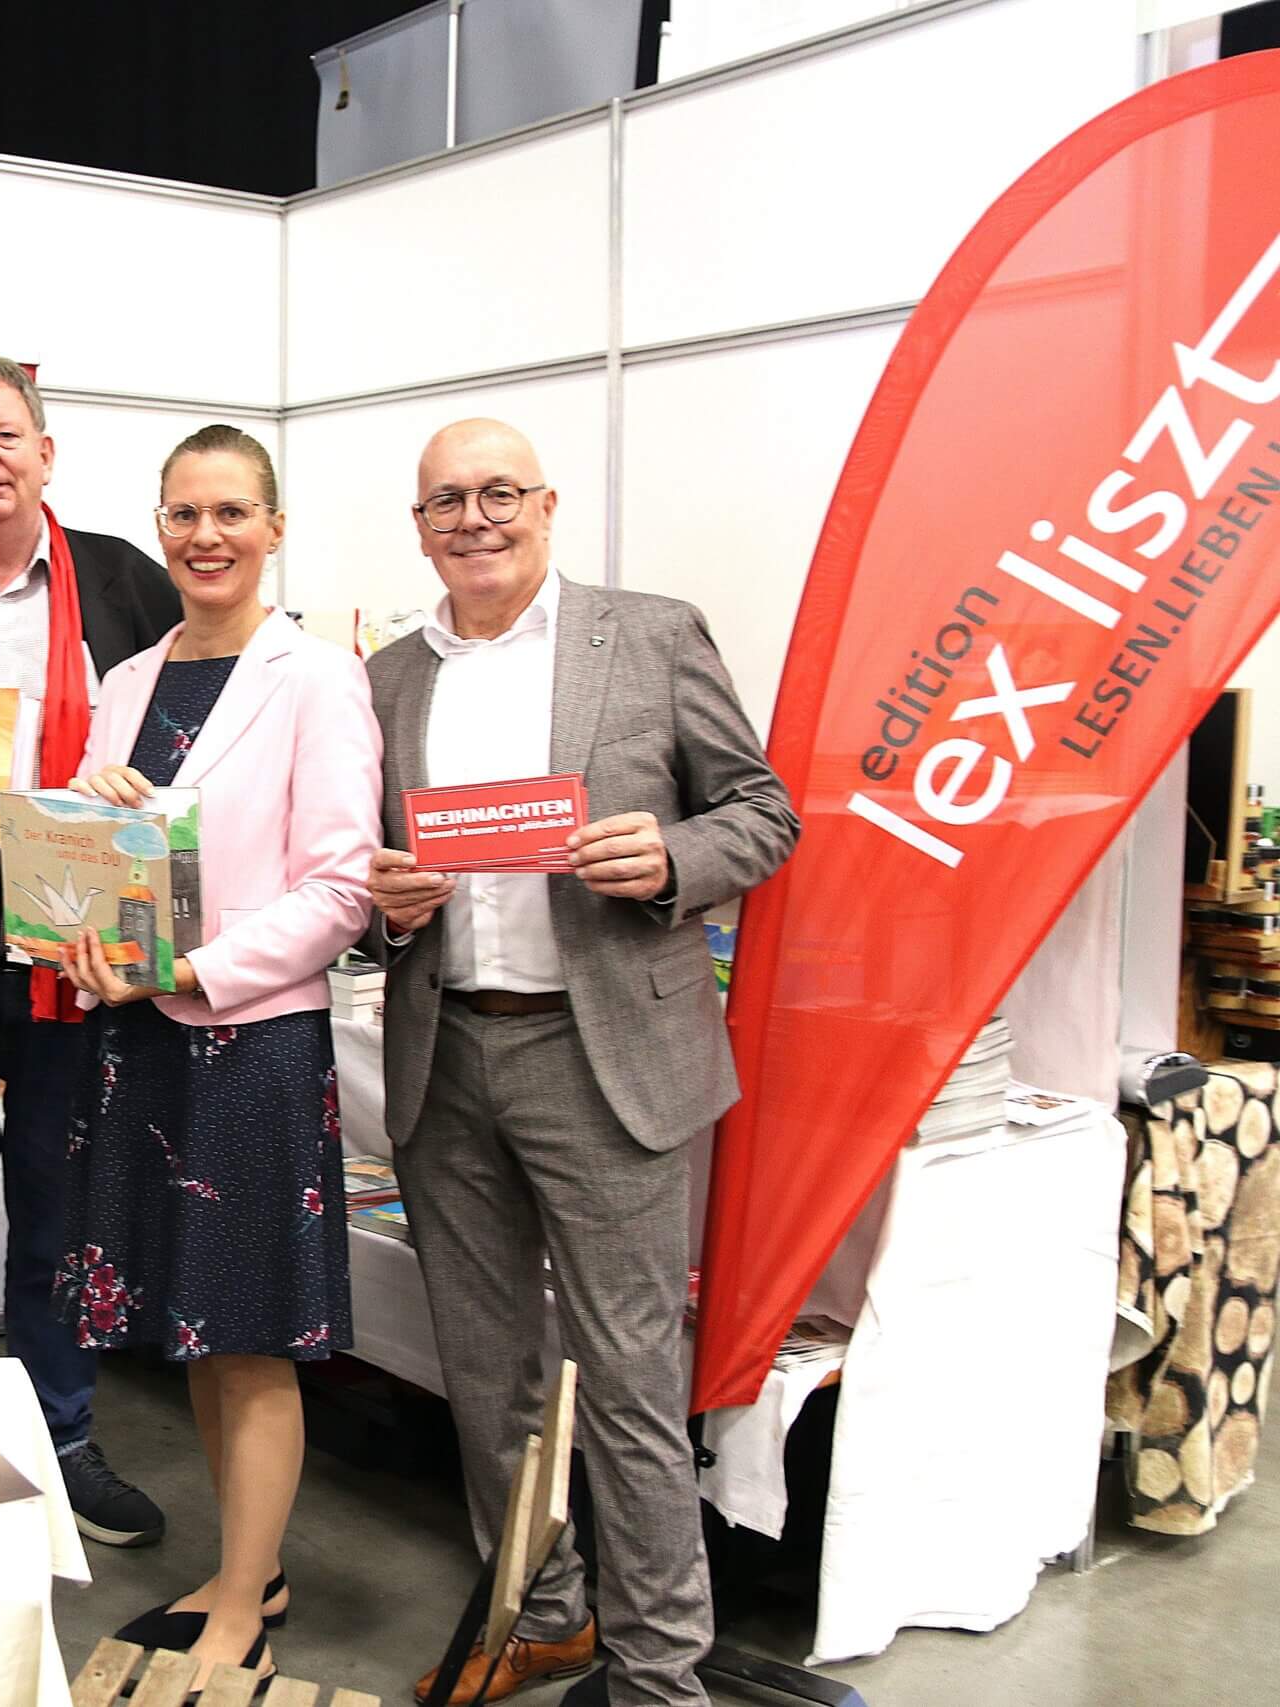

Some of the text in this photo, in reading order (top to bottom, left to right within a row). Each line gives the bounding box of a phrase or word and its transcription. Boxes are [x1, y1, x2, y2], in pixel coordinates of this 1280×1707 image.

[845, 232, 1280, 868] lex liszt
[858, 584, 999, 782] edition
[46, 831, 96, 849] Kranich
[415, 798, 573, 827] WEIHNACHTEN
